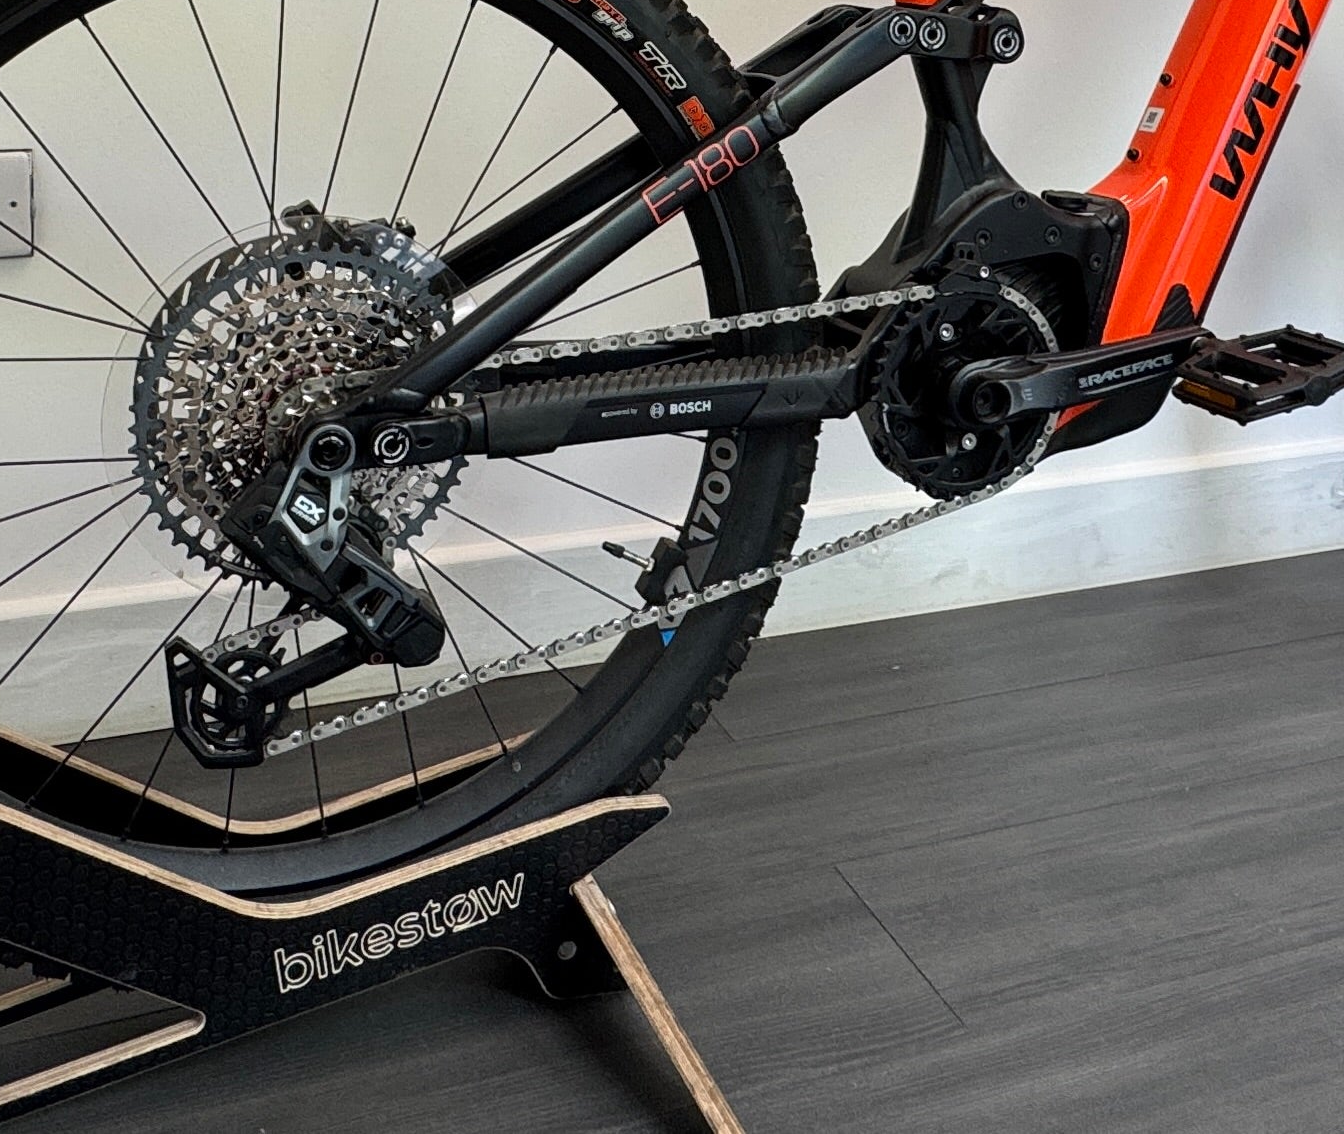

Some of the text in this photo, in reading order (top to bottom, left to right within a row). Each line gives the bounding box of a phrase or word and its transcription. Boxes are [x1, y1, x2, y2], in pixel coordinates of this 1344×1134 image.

[592, 9, 635, 42] grip
[639, 41, 687, 91] TR
[642, 125, 760, 224] E-180
[669, 400, 712, 415] BOSCH
[294, 495, 325, 521] GX
[688, 436, 738, 542] 1700
